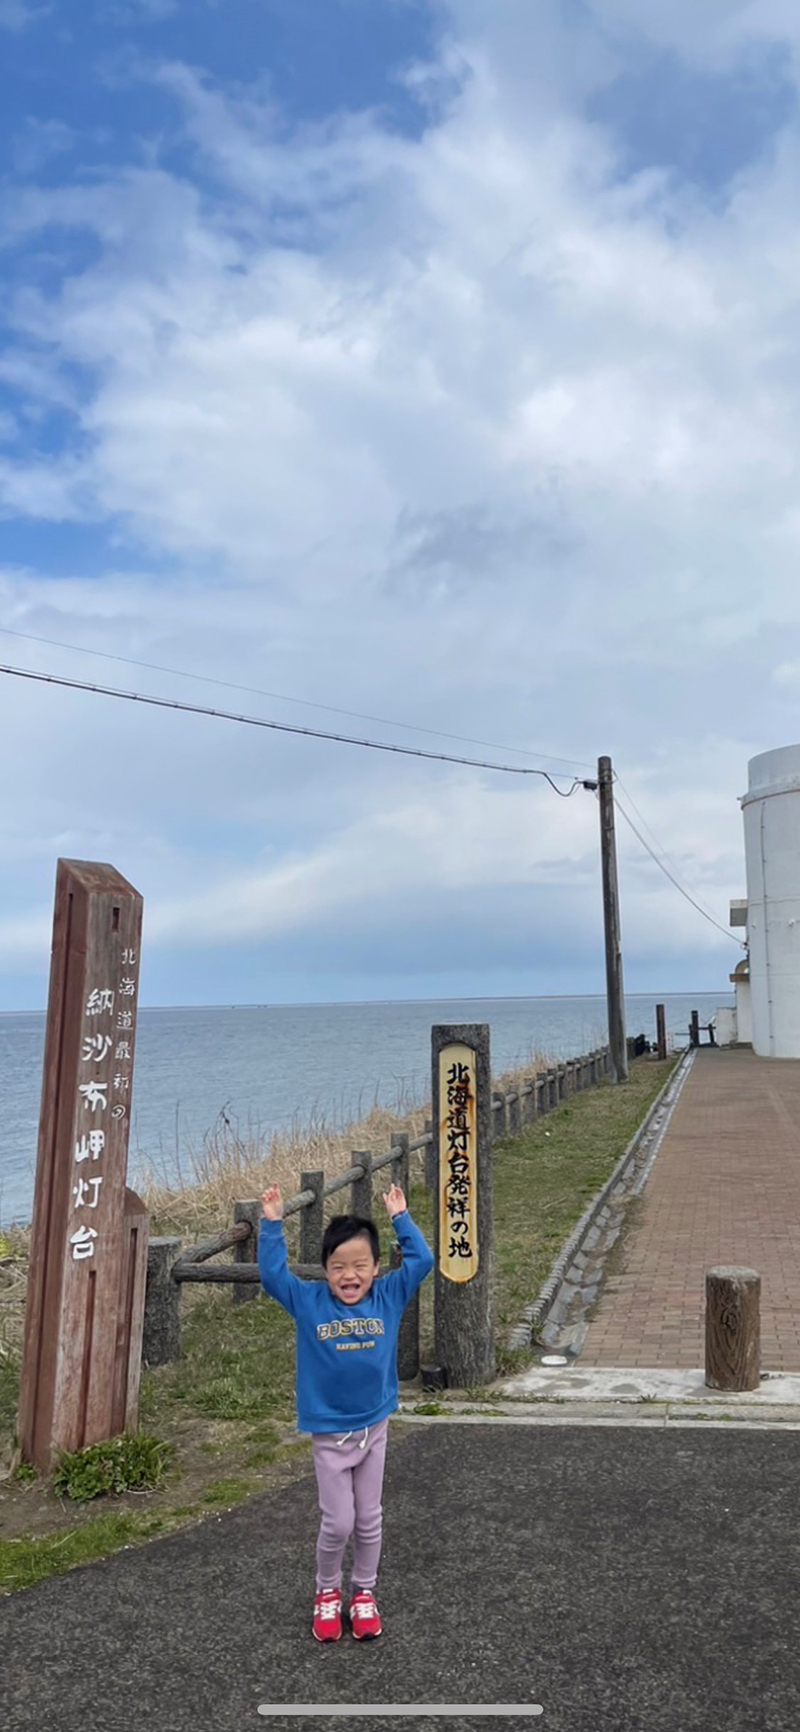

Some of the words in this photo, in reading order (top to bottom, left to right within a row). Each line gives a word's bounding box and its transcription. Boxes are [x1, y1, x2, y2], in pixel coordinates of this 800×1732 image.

[69, 988, 115, 1260] 納沙布岬灯台
[111, 947, 137, 1121] 北海道最初の
[446, 1062, 473, 1258] 北海道灯台発祥の地
[317, 1318, 385, 1340] BOSTON
